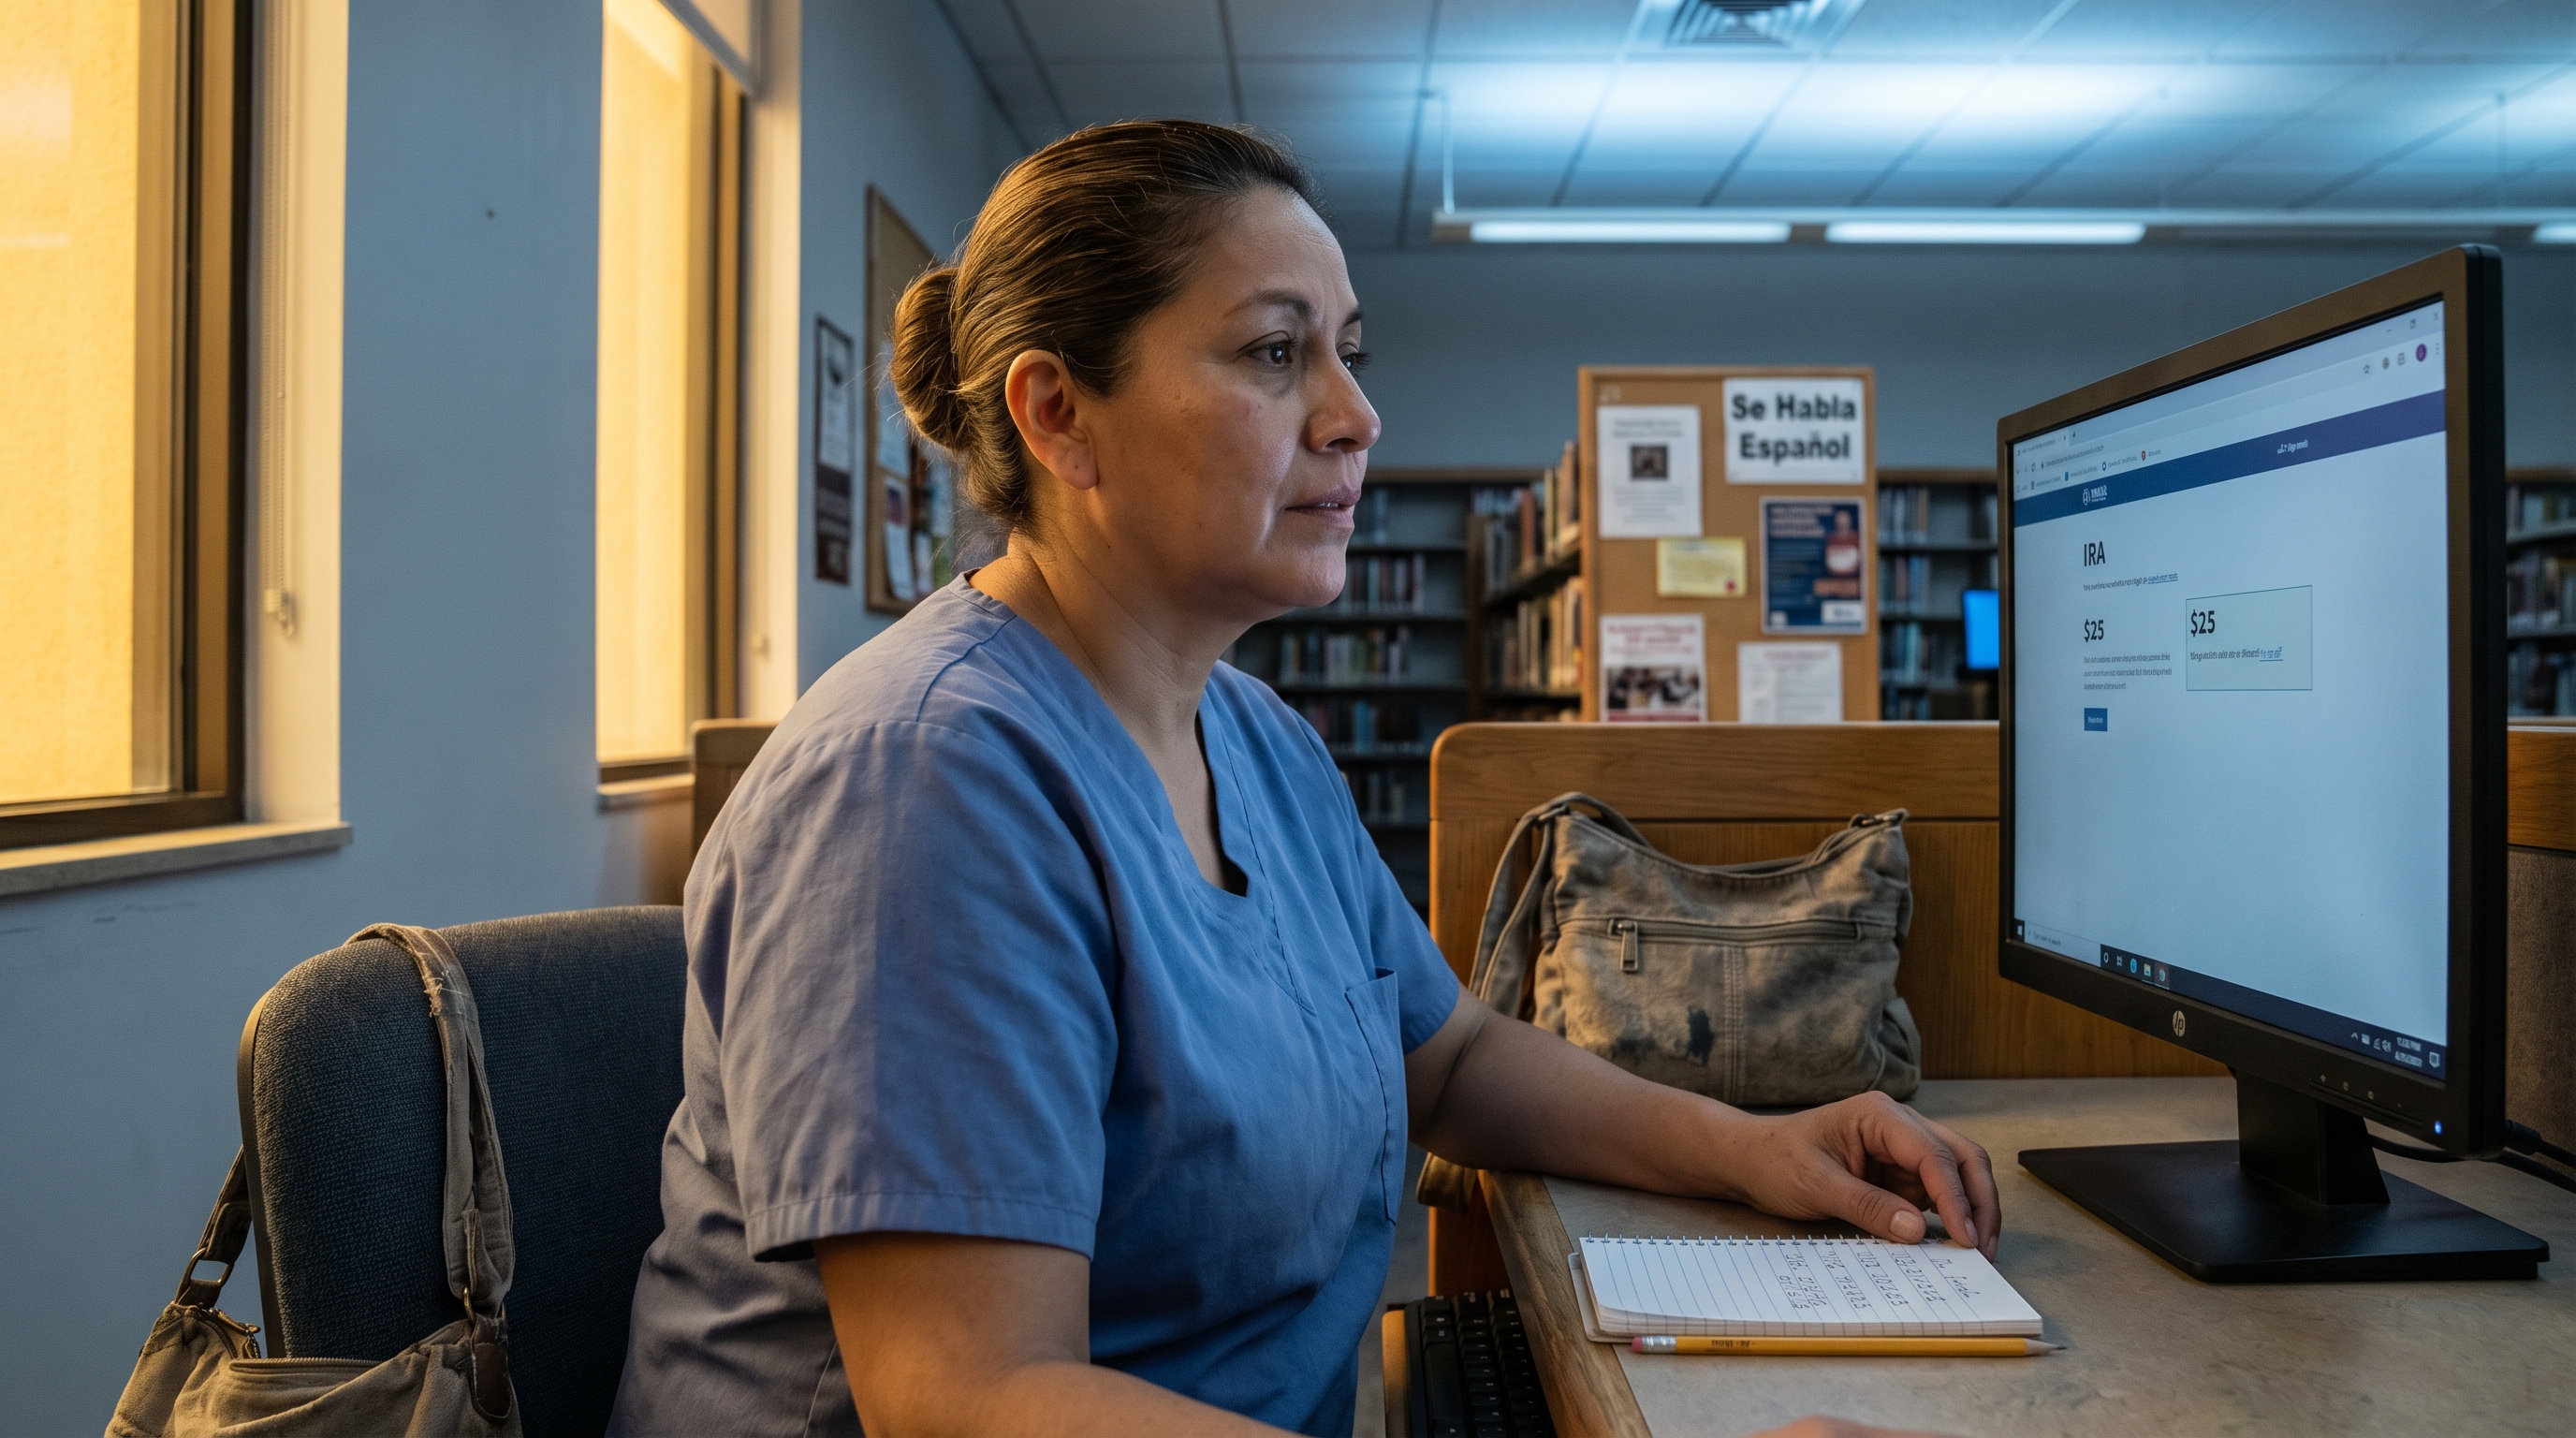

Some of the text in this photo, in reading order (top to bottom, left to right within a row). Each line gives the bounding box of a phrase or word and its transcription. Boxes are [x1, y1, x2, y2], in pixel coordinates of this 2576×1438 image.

[1732, 393, 1856, 421] Se Habla
[1740, 433, 1850, 465] Español
[2084, 541, 2105, 566] IRA
[2084, 619, 2104, 643] $25
[2190, 609, 2216, 638] $25
[2174, 1011, 2185, 1036] hp
